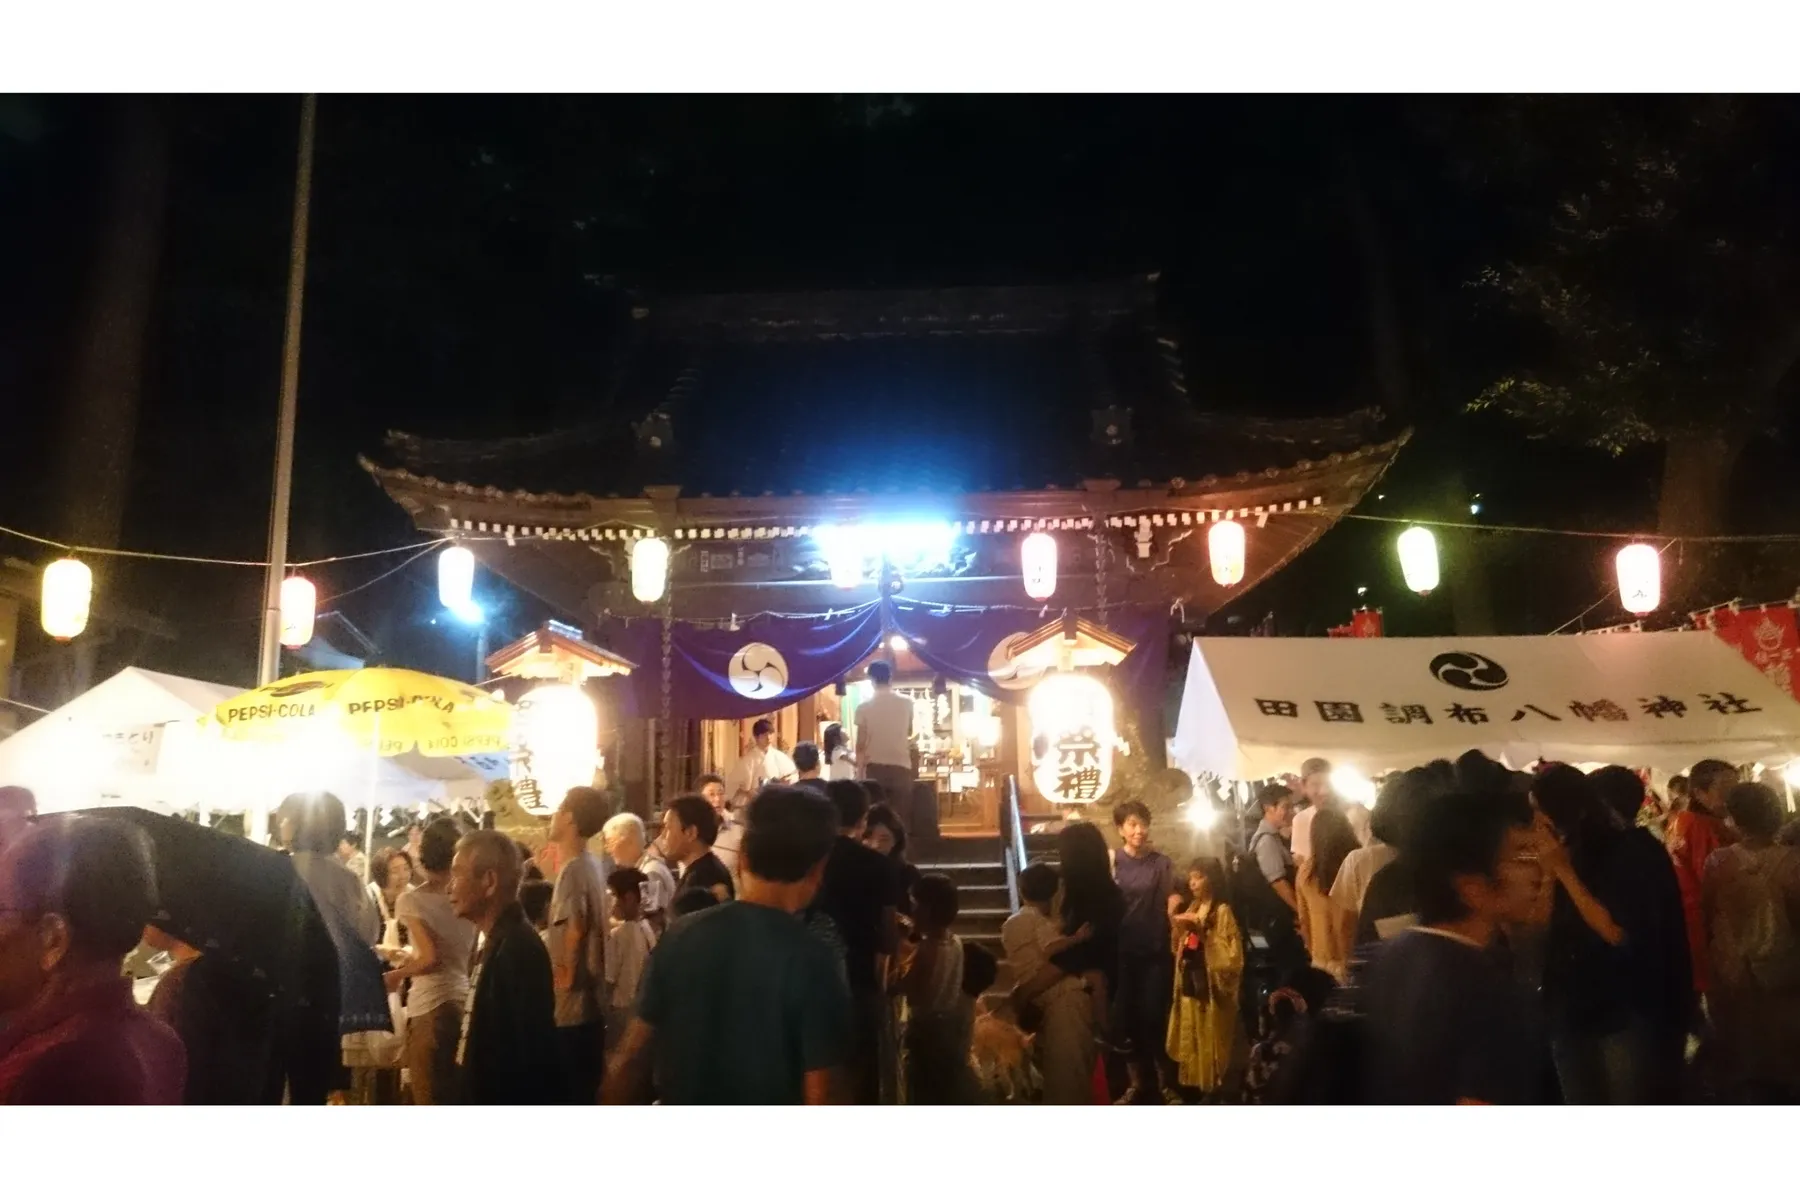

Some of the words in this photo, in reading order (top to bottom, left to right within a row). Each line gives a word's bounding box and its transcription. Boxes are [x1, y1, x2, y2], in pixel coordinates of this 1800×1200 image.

[1253, 691, 1763, 725] 田園調布八幡神社
